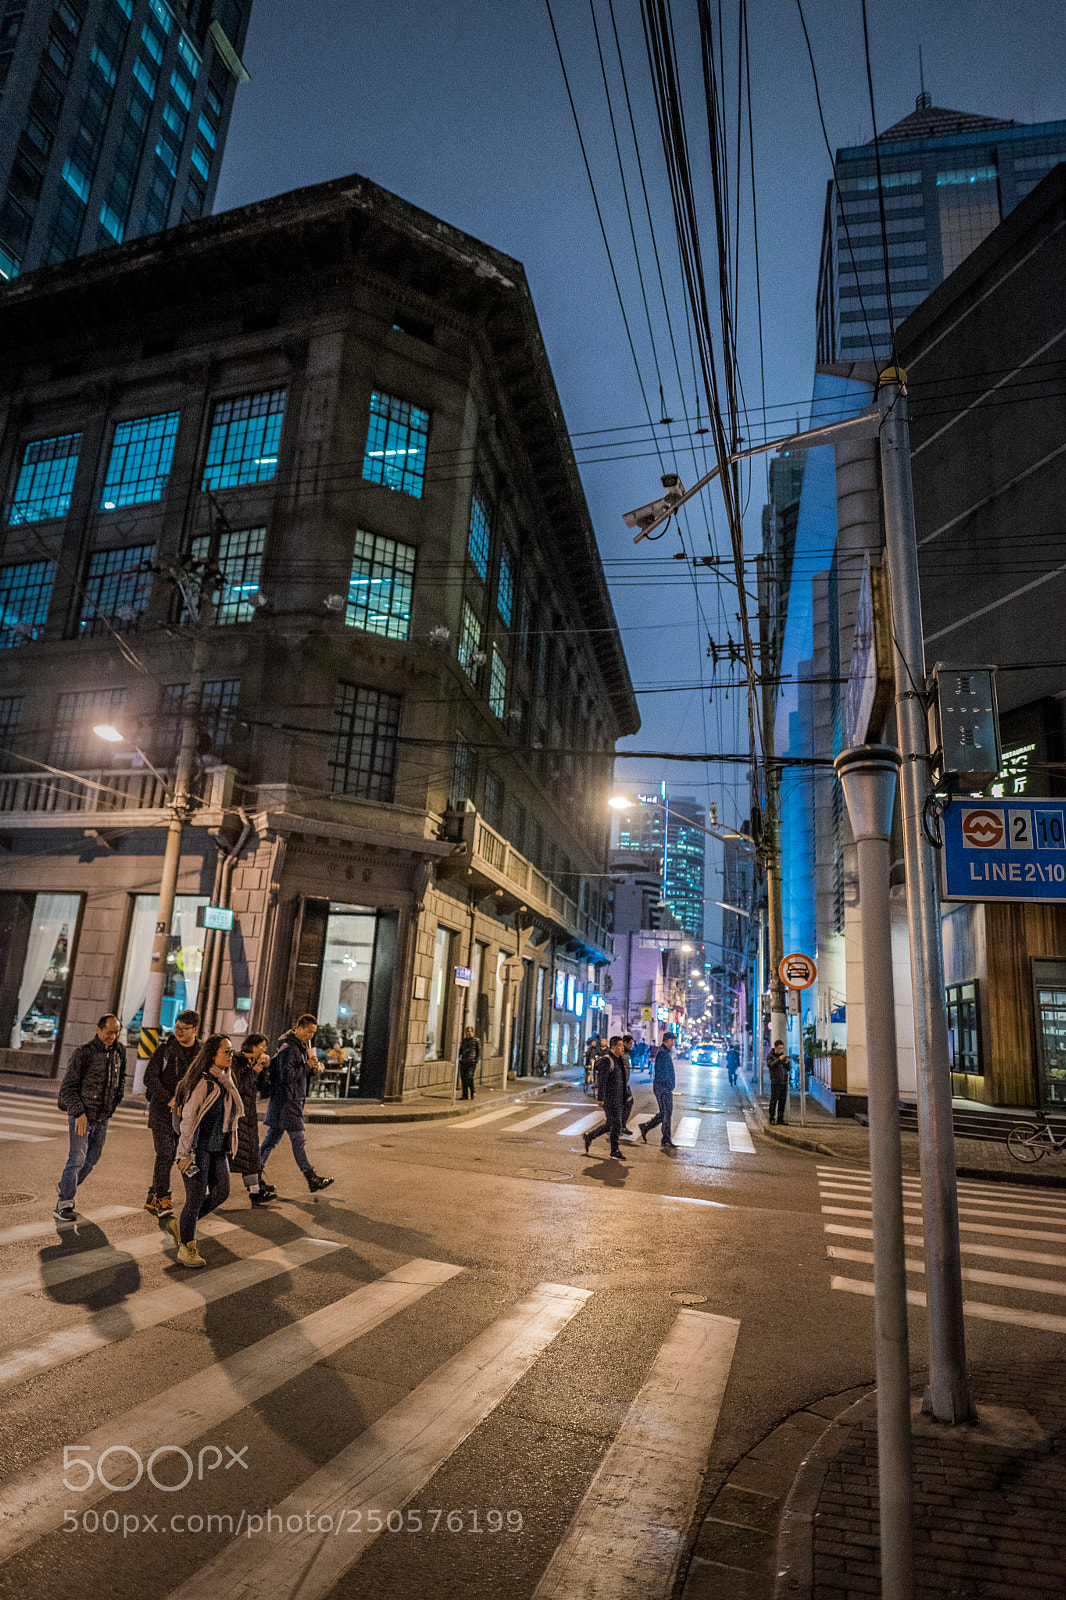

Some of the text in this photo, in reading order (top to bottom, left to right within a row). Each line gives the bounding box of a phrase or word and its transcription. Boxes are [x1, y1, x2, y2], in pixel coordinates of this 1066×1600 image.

[1002, 744, 1036, 760] ESTAURANT
[1013, 817, 1062, 842] 2 10
